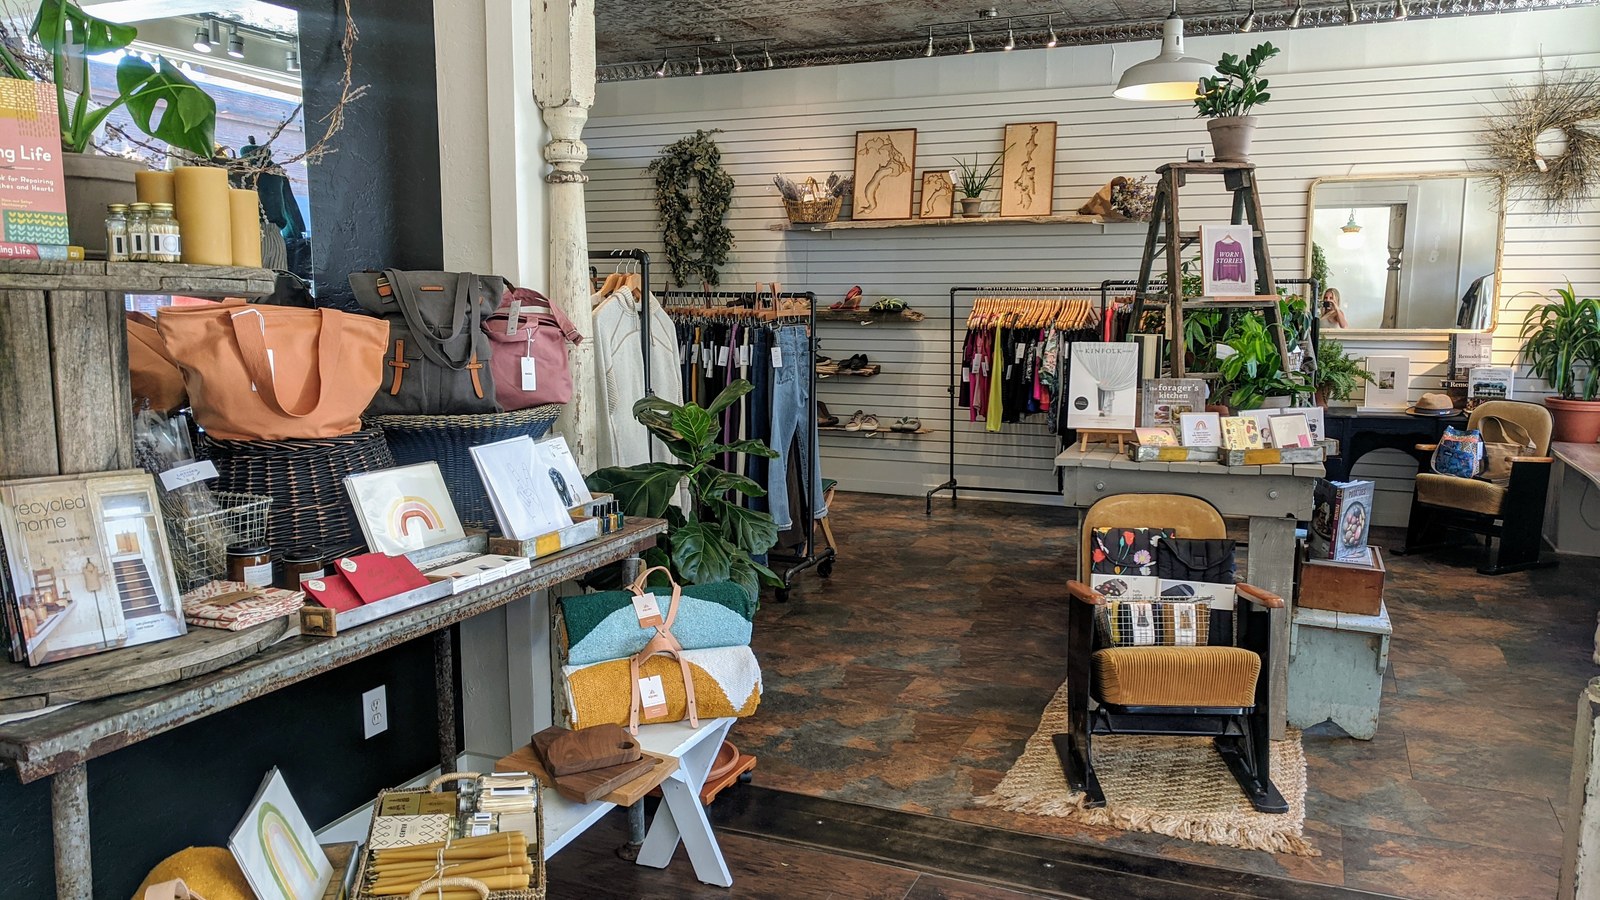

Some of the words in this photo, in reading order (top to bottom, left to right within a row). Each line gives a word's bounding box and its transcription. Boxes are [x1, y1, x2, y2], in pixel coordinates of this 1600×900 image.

[20, 145, 52, 161] Life
[20, 176, 54, 186] Repairing
[31, 184, 54, 193] Hearts
[0, 245, 13, 257] ing
[14, 245, 31, 255] Life
[1158, 384, 1199, 393] forager's
[1158, 391, 1189, 399] kitchen
[13, 494, 86, 516] recycled
[16, 517, 66, 532] home
